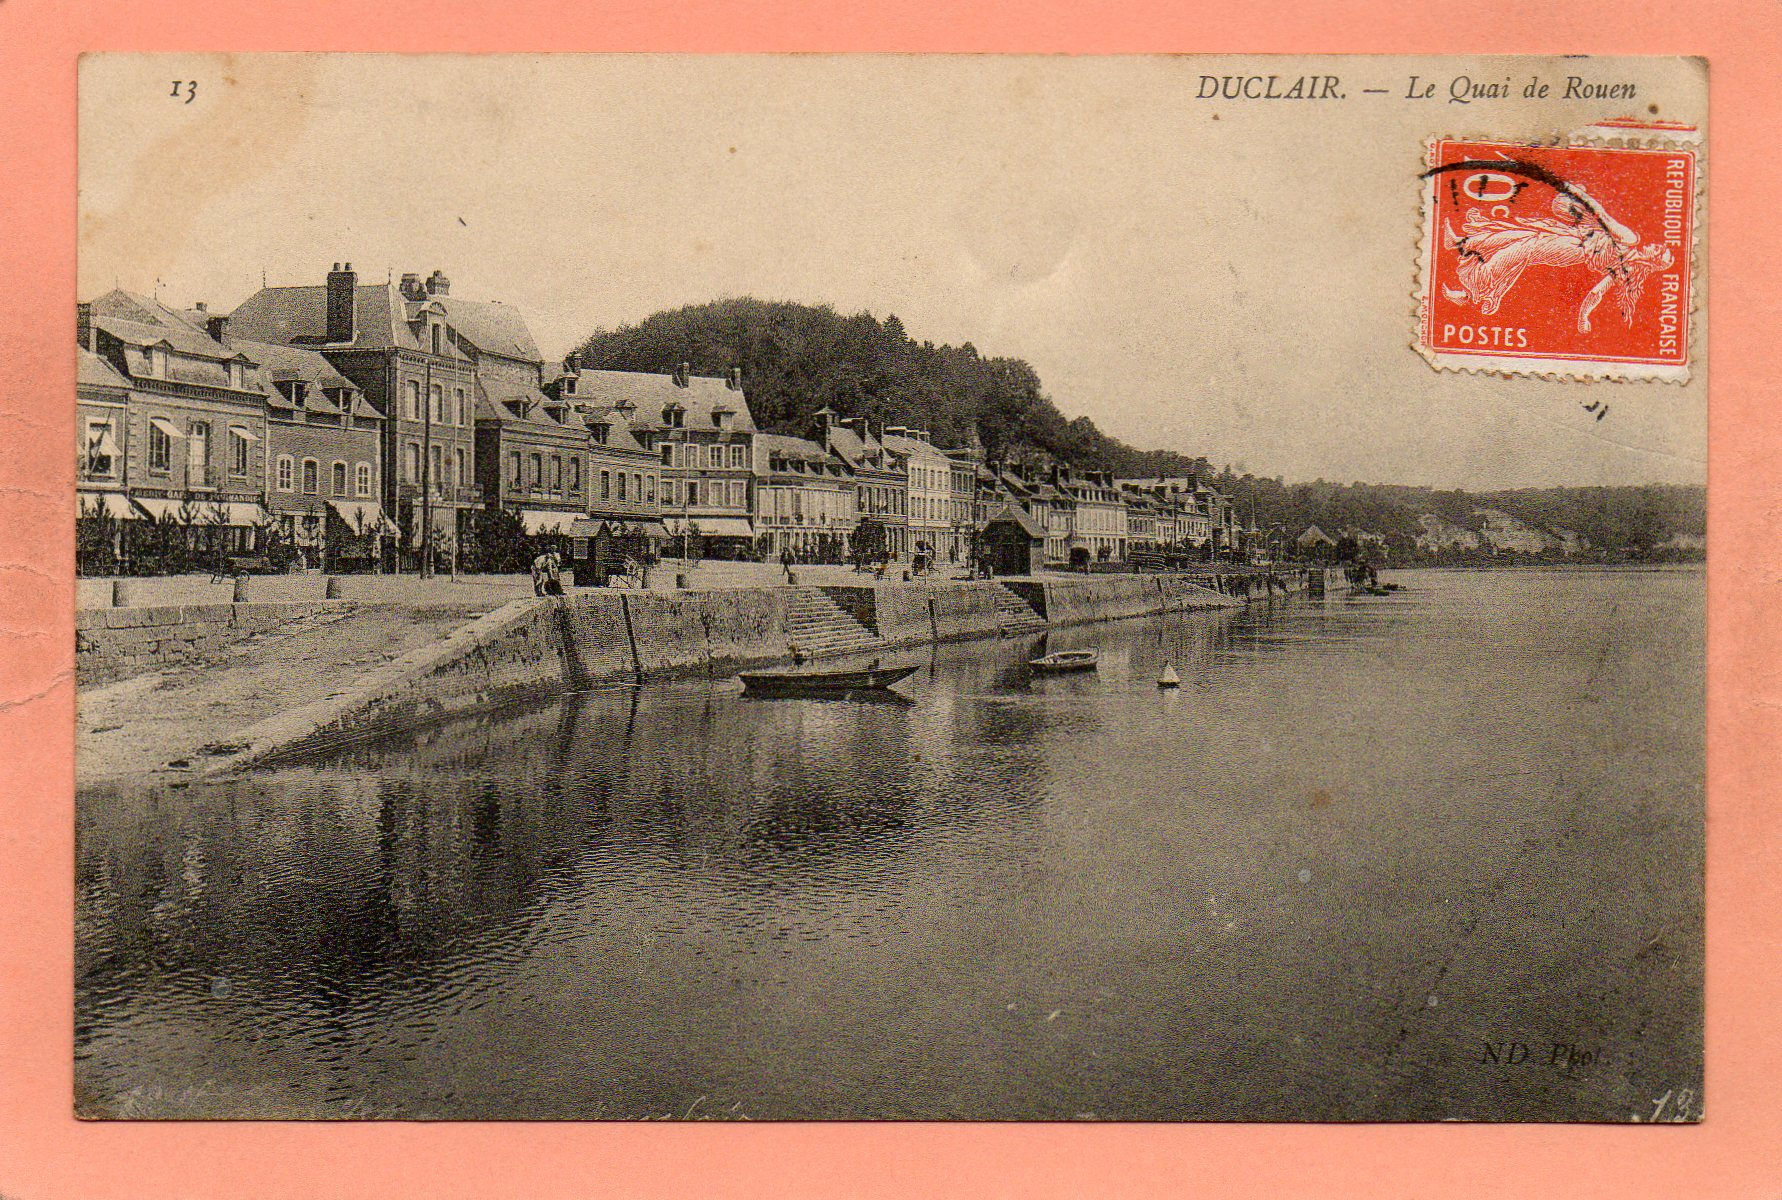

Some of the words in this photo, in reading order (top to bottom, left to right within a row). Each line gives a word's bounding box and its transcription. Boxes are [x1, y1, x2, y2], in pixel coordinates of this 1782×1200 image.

[1662, 159, 1685, 248] REPUBLIQUE
[1443, 323, 1528, 349] POSTES
[1658, 273, 1680, 356] FRANÇAISE
